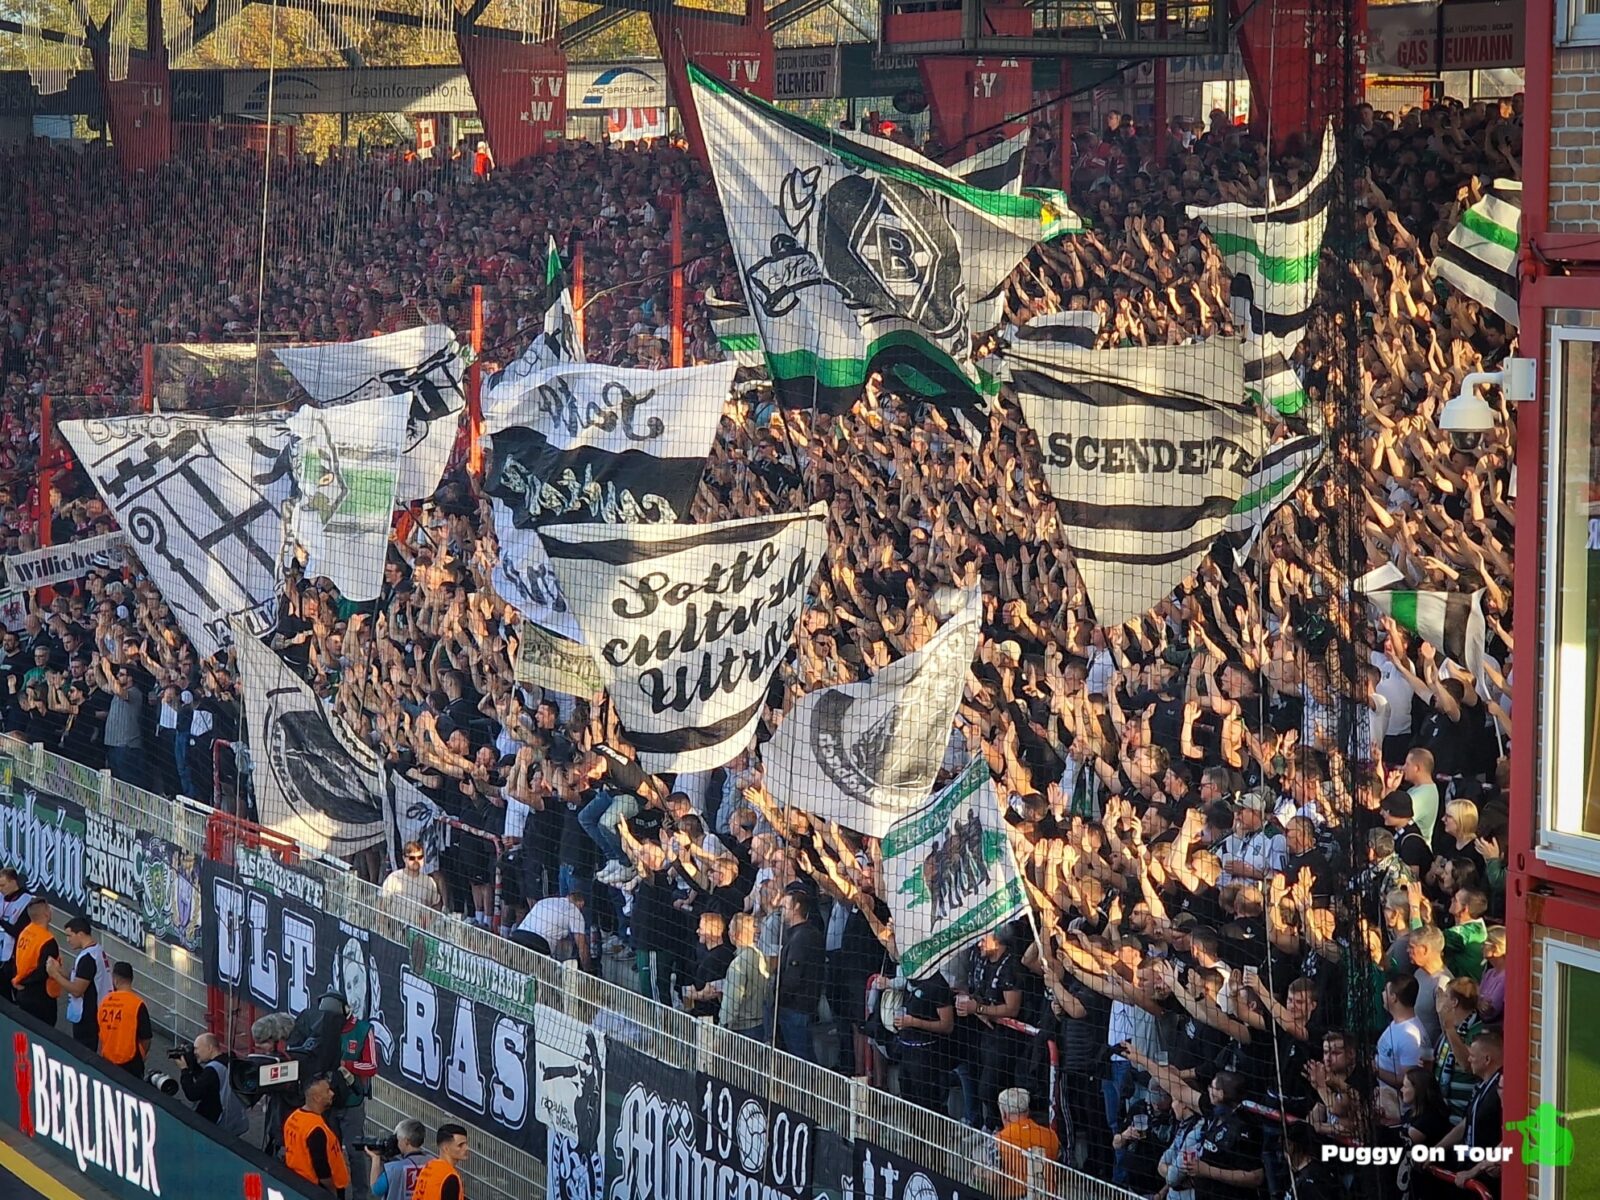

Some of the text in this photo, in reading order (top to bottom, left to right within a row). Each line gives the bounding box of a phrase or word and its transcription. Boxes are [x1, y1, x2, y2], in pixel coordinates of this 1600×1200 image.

[1397, 40, 1428, 66] GAS
[350, 82, 457, 98] Geoinformation
[777, 71, 826, 94] ELEMENT
[612, 542, 780, 619] Sotto
[101, 1009, 122, 1023] 214
[31, 1043, 162, 1198] BERLINER
